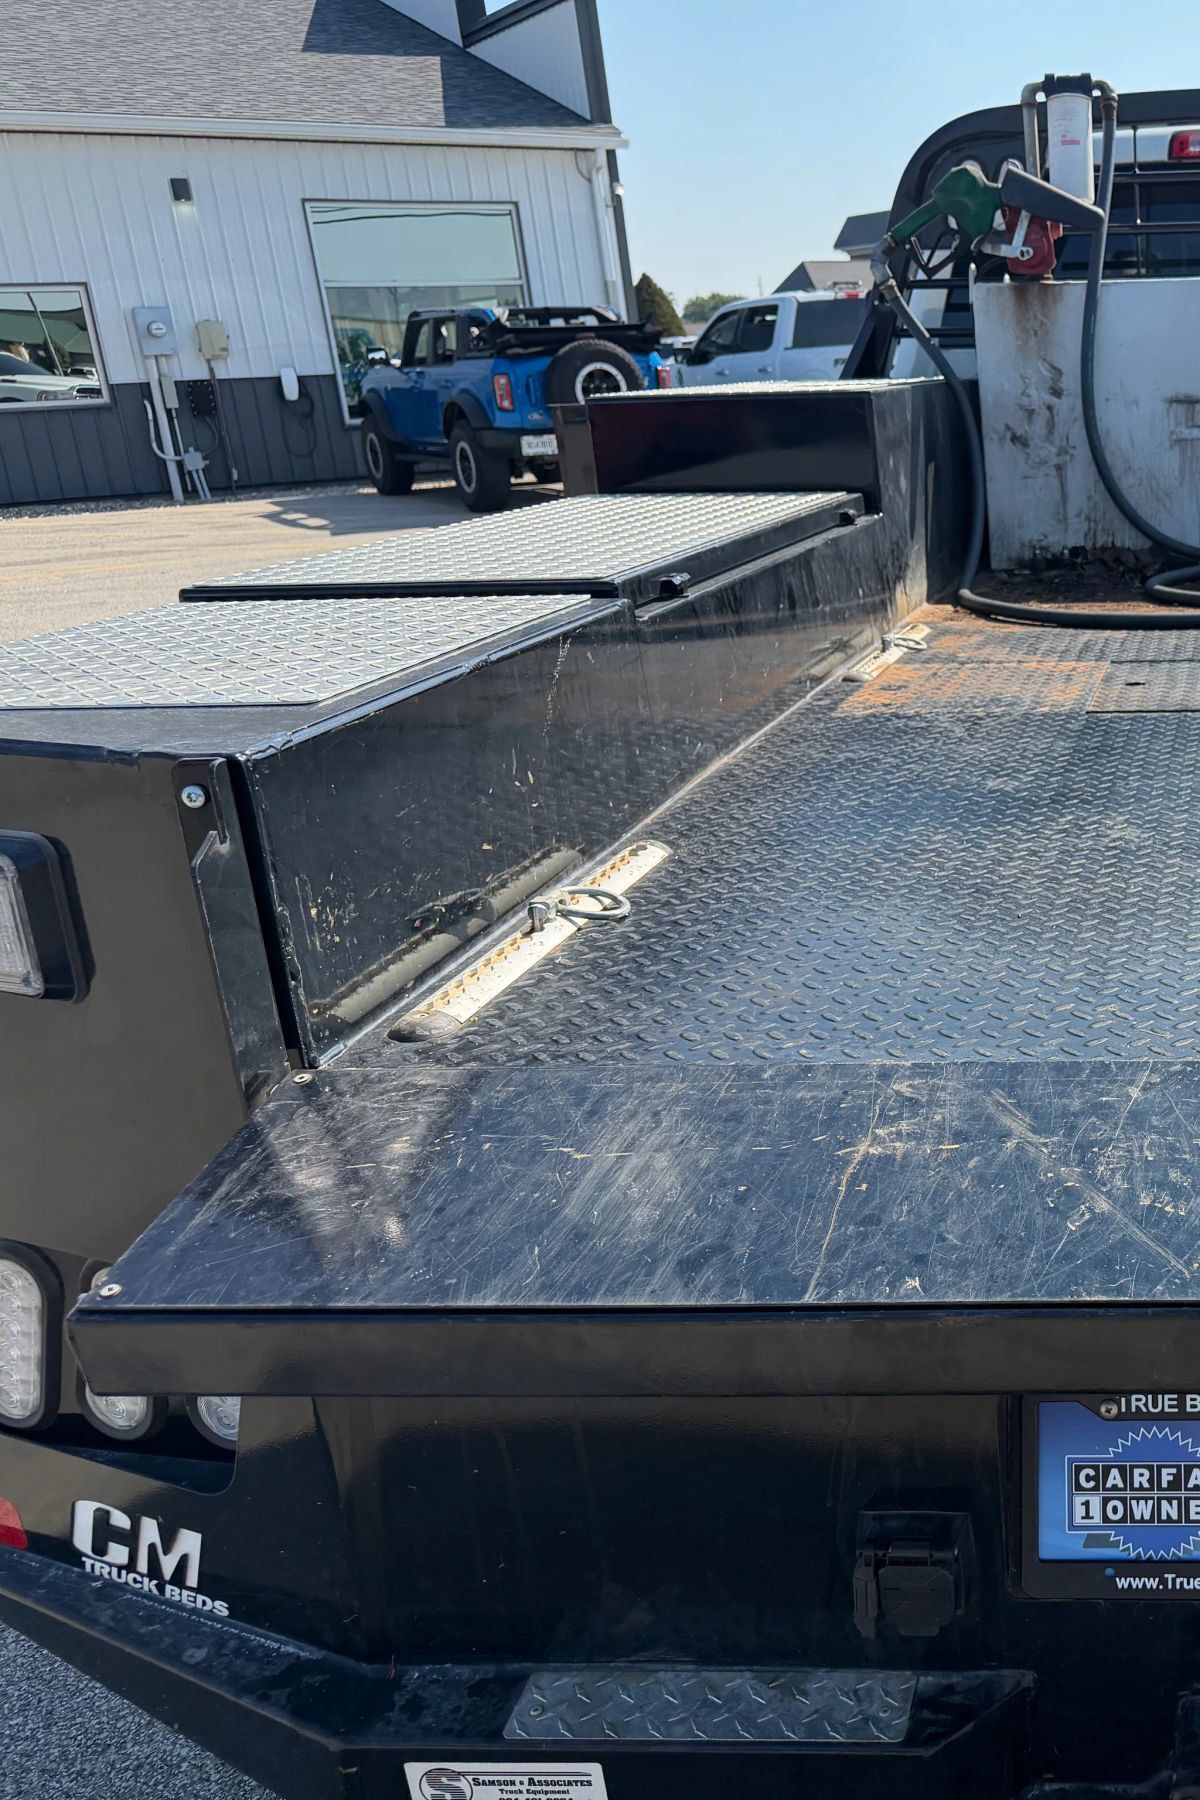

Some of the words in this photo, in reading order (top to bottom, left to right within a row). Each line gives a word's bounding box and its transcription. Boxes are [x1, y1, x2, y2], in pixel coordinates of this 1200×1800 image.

[1080, 1499, 1095, 1521] 1
[72, 1499, 202, 1588] CM
[81, 1556, 160, 1596] TRUCK
[165, 1584, 230, 1617] BEDS
[525, 1788, 570, 1796] Equipment
